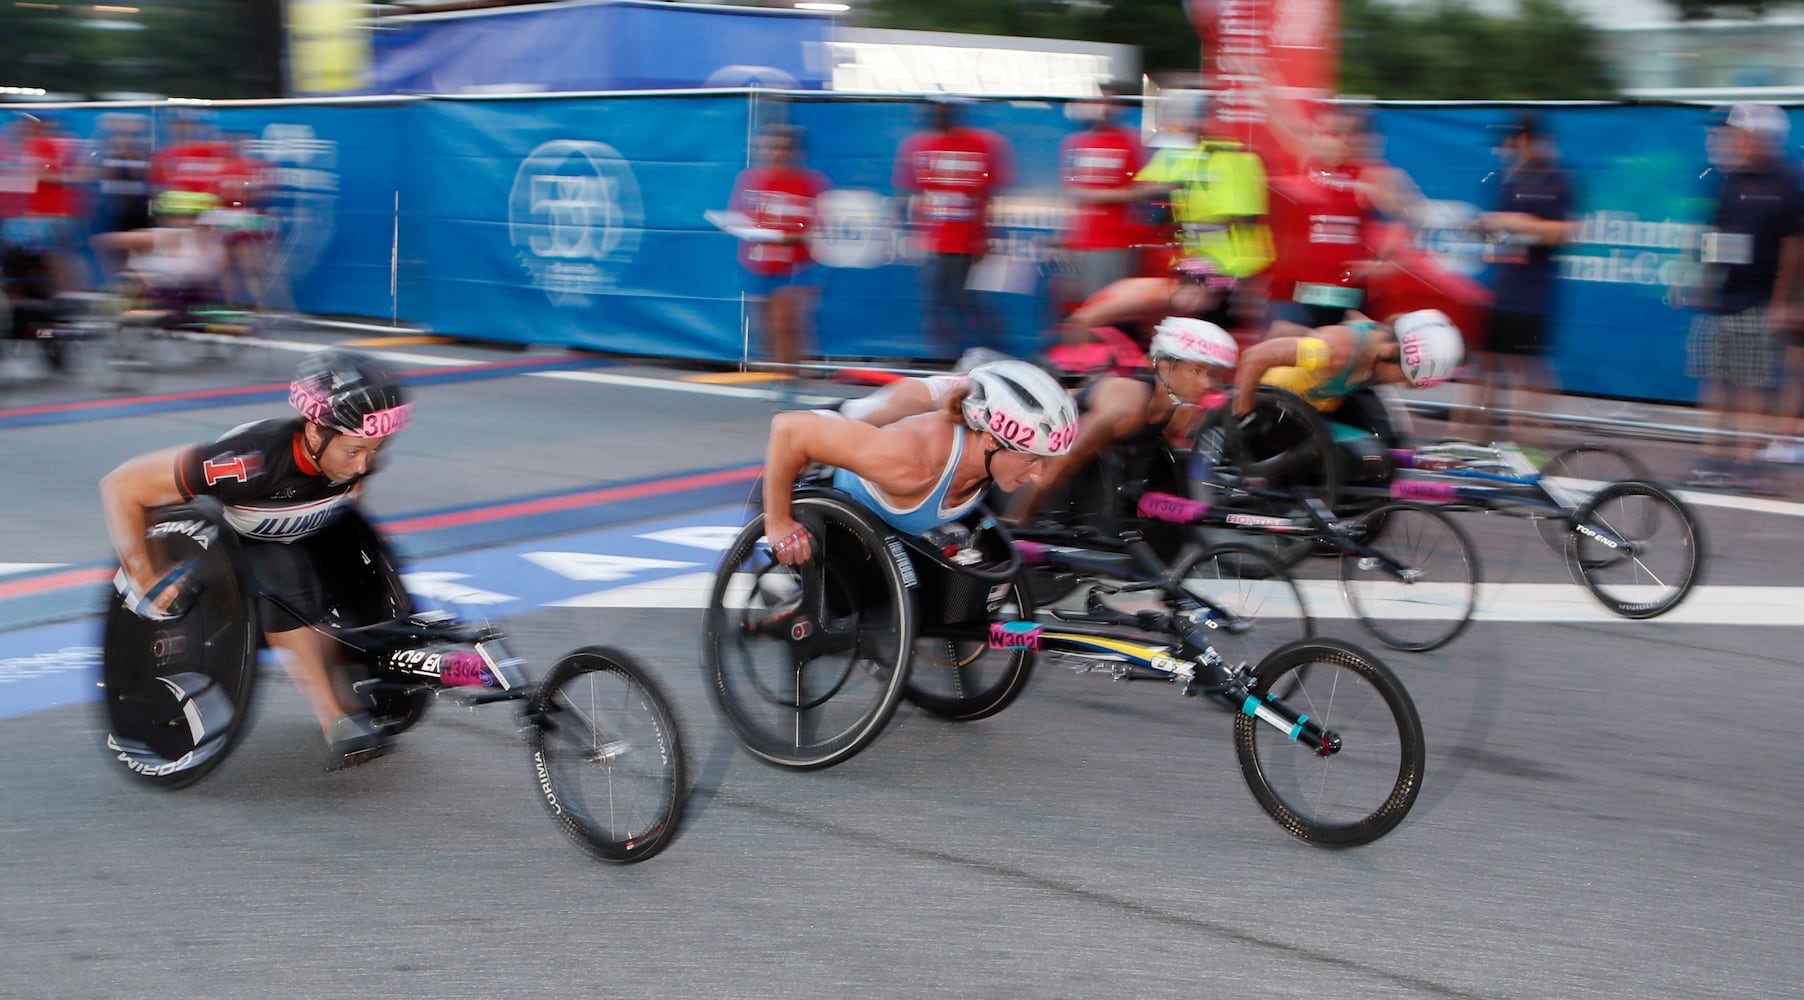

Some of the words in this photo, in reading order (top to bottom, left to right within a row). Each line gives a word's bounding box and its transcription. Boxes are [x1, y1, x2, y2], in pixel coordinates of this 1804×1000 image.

[989, 411, 1036, 449] 302
[1576, 524, 1596, 536] TOP
[1594, 534, 1618, 549] END
[989, 630, 1037, 656] W302
[421, 653, 441, 673] EN
[107, 733, 194, 776] CORIMA
[534, 752, 562, 815] CORIMA
